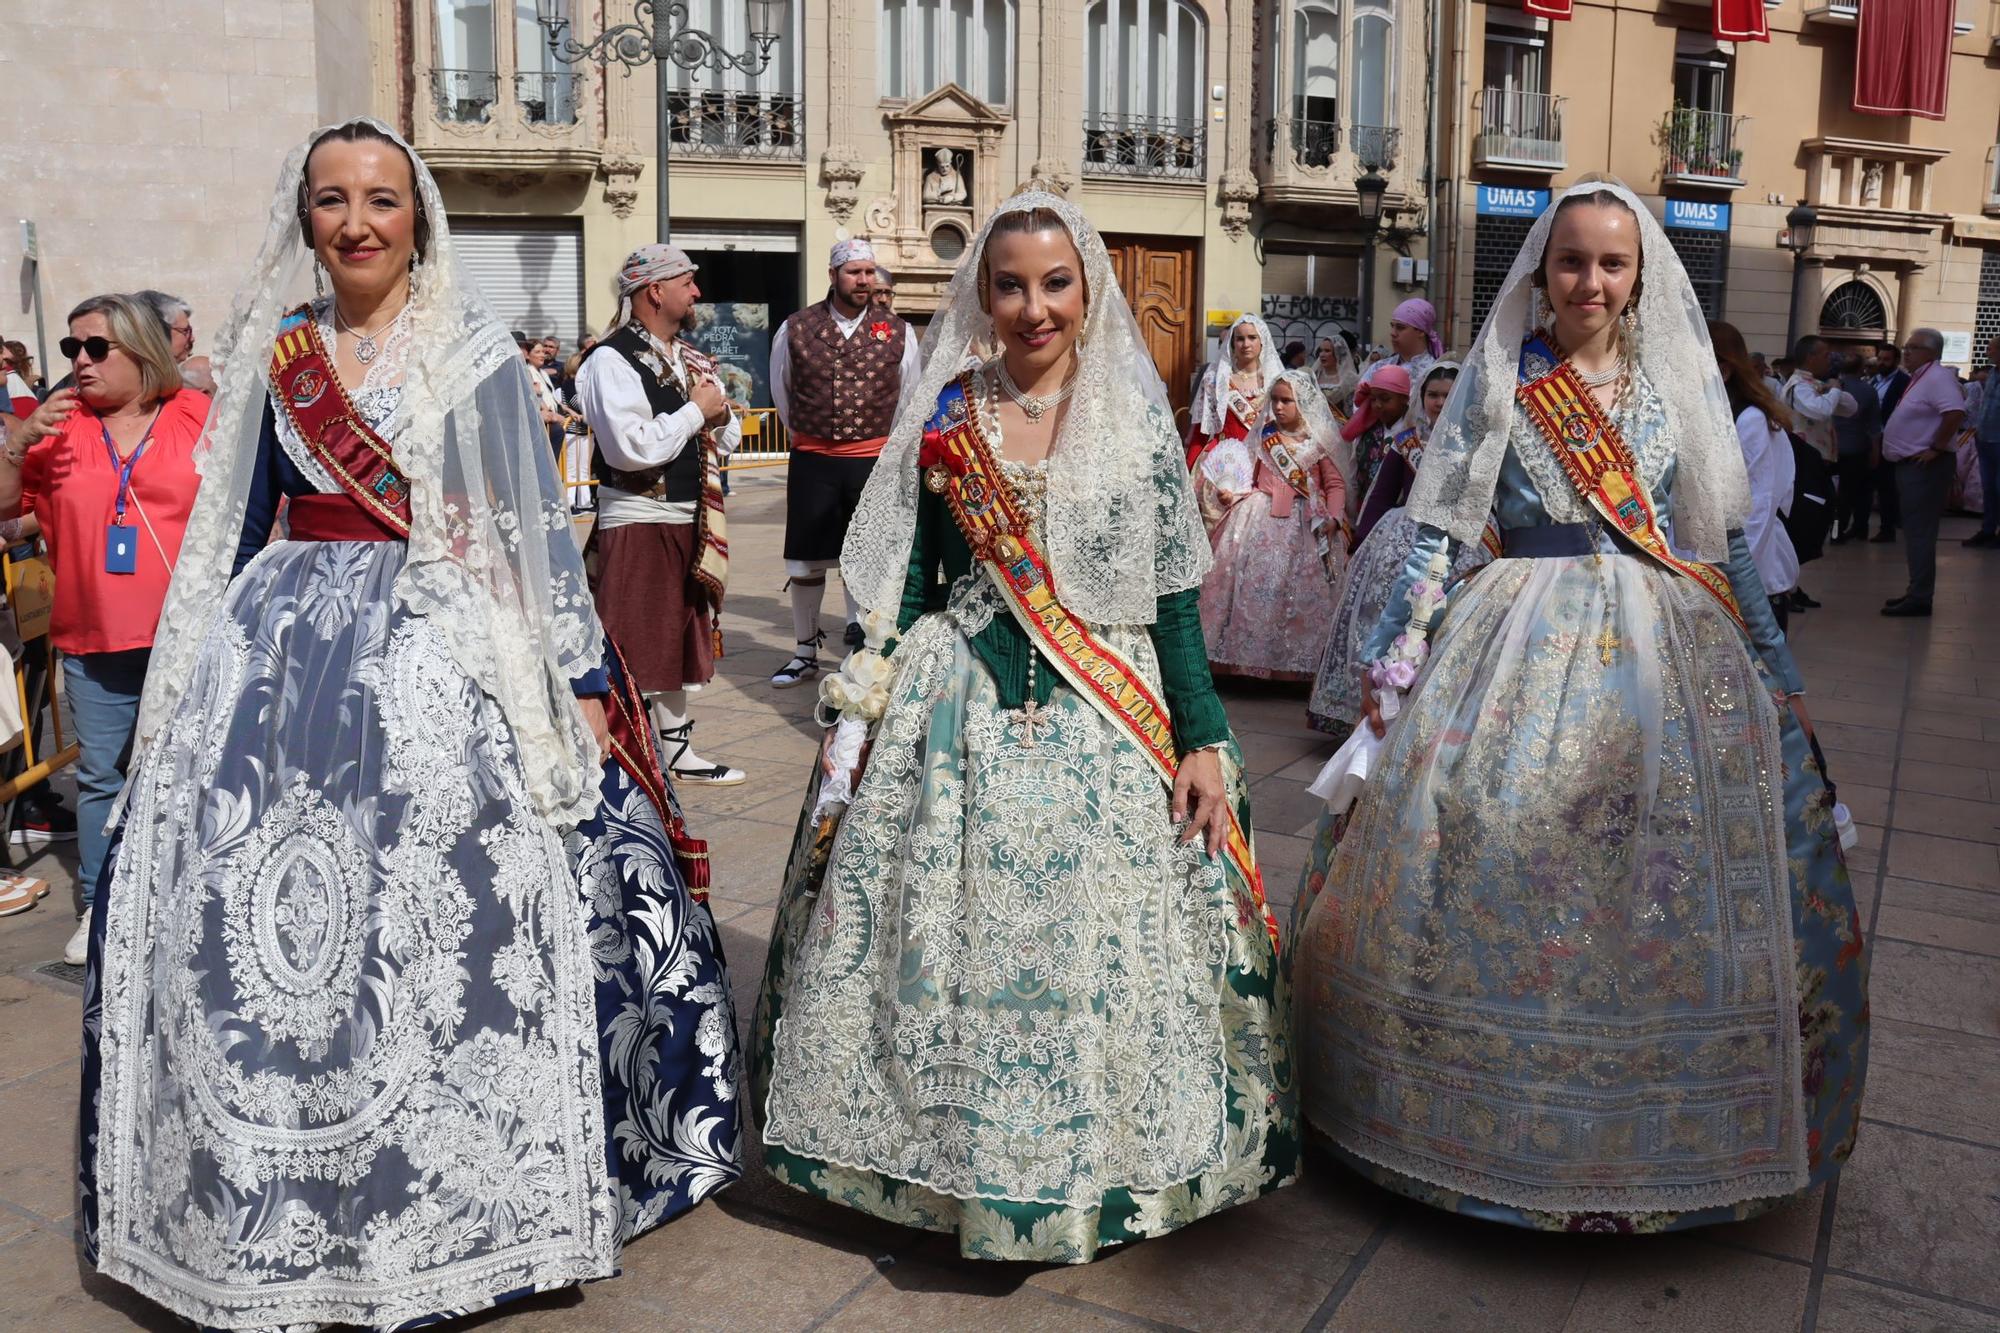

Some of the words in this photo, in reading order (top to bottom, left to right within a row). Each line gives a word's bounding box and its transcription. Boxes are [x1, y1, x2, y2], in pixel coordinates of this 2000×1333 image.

[1487, 187, 1536, 207] UMAS
[1674, 201, 1718, 221] UMAS
[713, 326, 738, 334] TOTA
[703, 334, 735, 342] PEDRA
[710, 347, 739, 355] PARET
[1029, 597, 1130, 702] FALLERA
